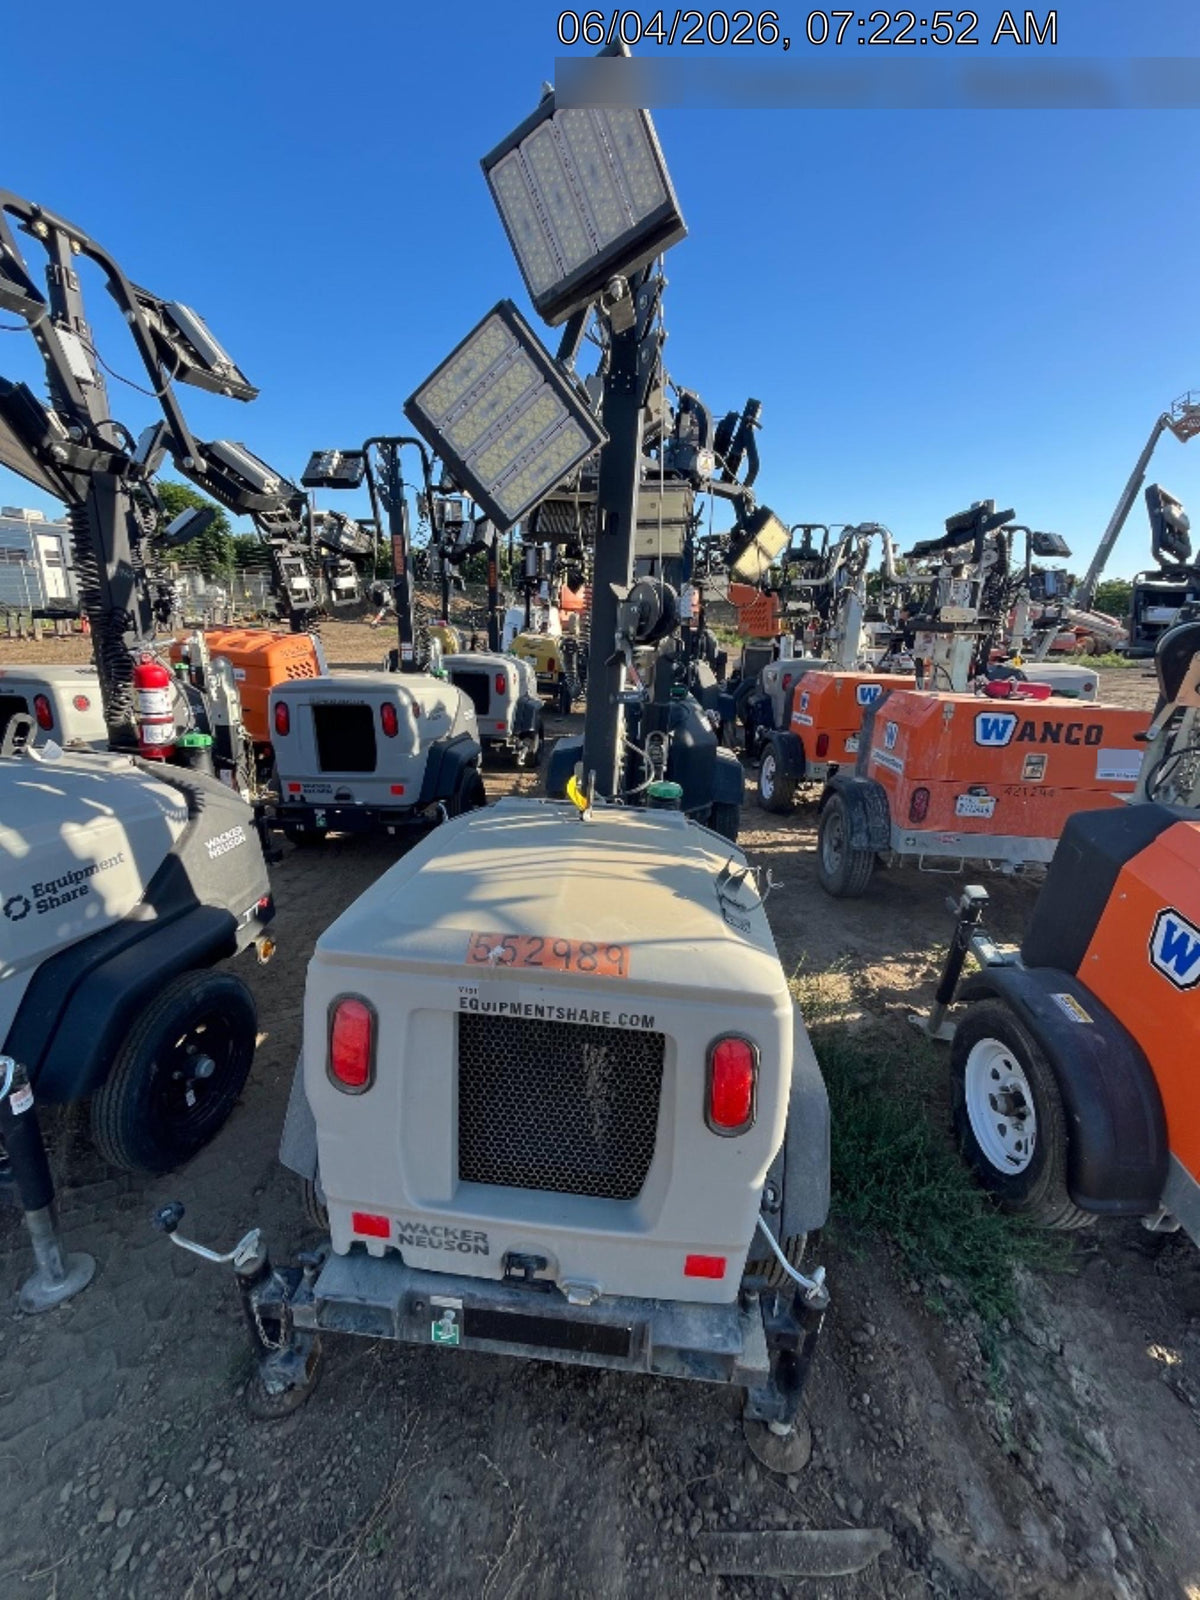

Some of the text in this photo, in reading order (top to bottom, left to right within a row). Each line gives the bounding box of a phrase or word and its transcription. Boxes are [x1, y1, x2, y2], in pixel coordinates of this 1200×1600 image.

[979, 714, 1103, 746] WANCO
[31, 851, 125, 899] Equipment
[35, 884, 89, 914] Share
[471, 934, 625, 976] 552989
[1160, 919, 1200, 977] W
[460, 996, 656, 1029] EQUIPMENTSHARE.COM
[396, 1220, 488, 1243] WACKER
[398, 1233, 490, 1256] NEUSON
